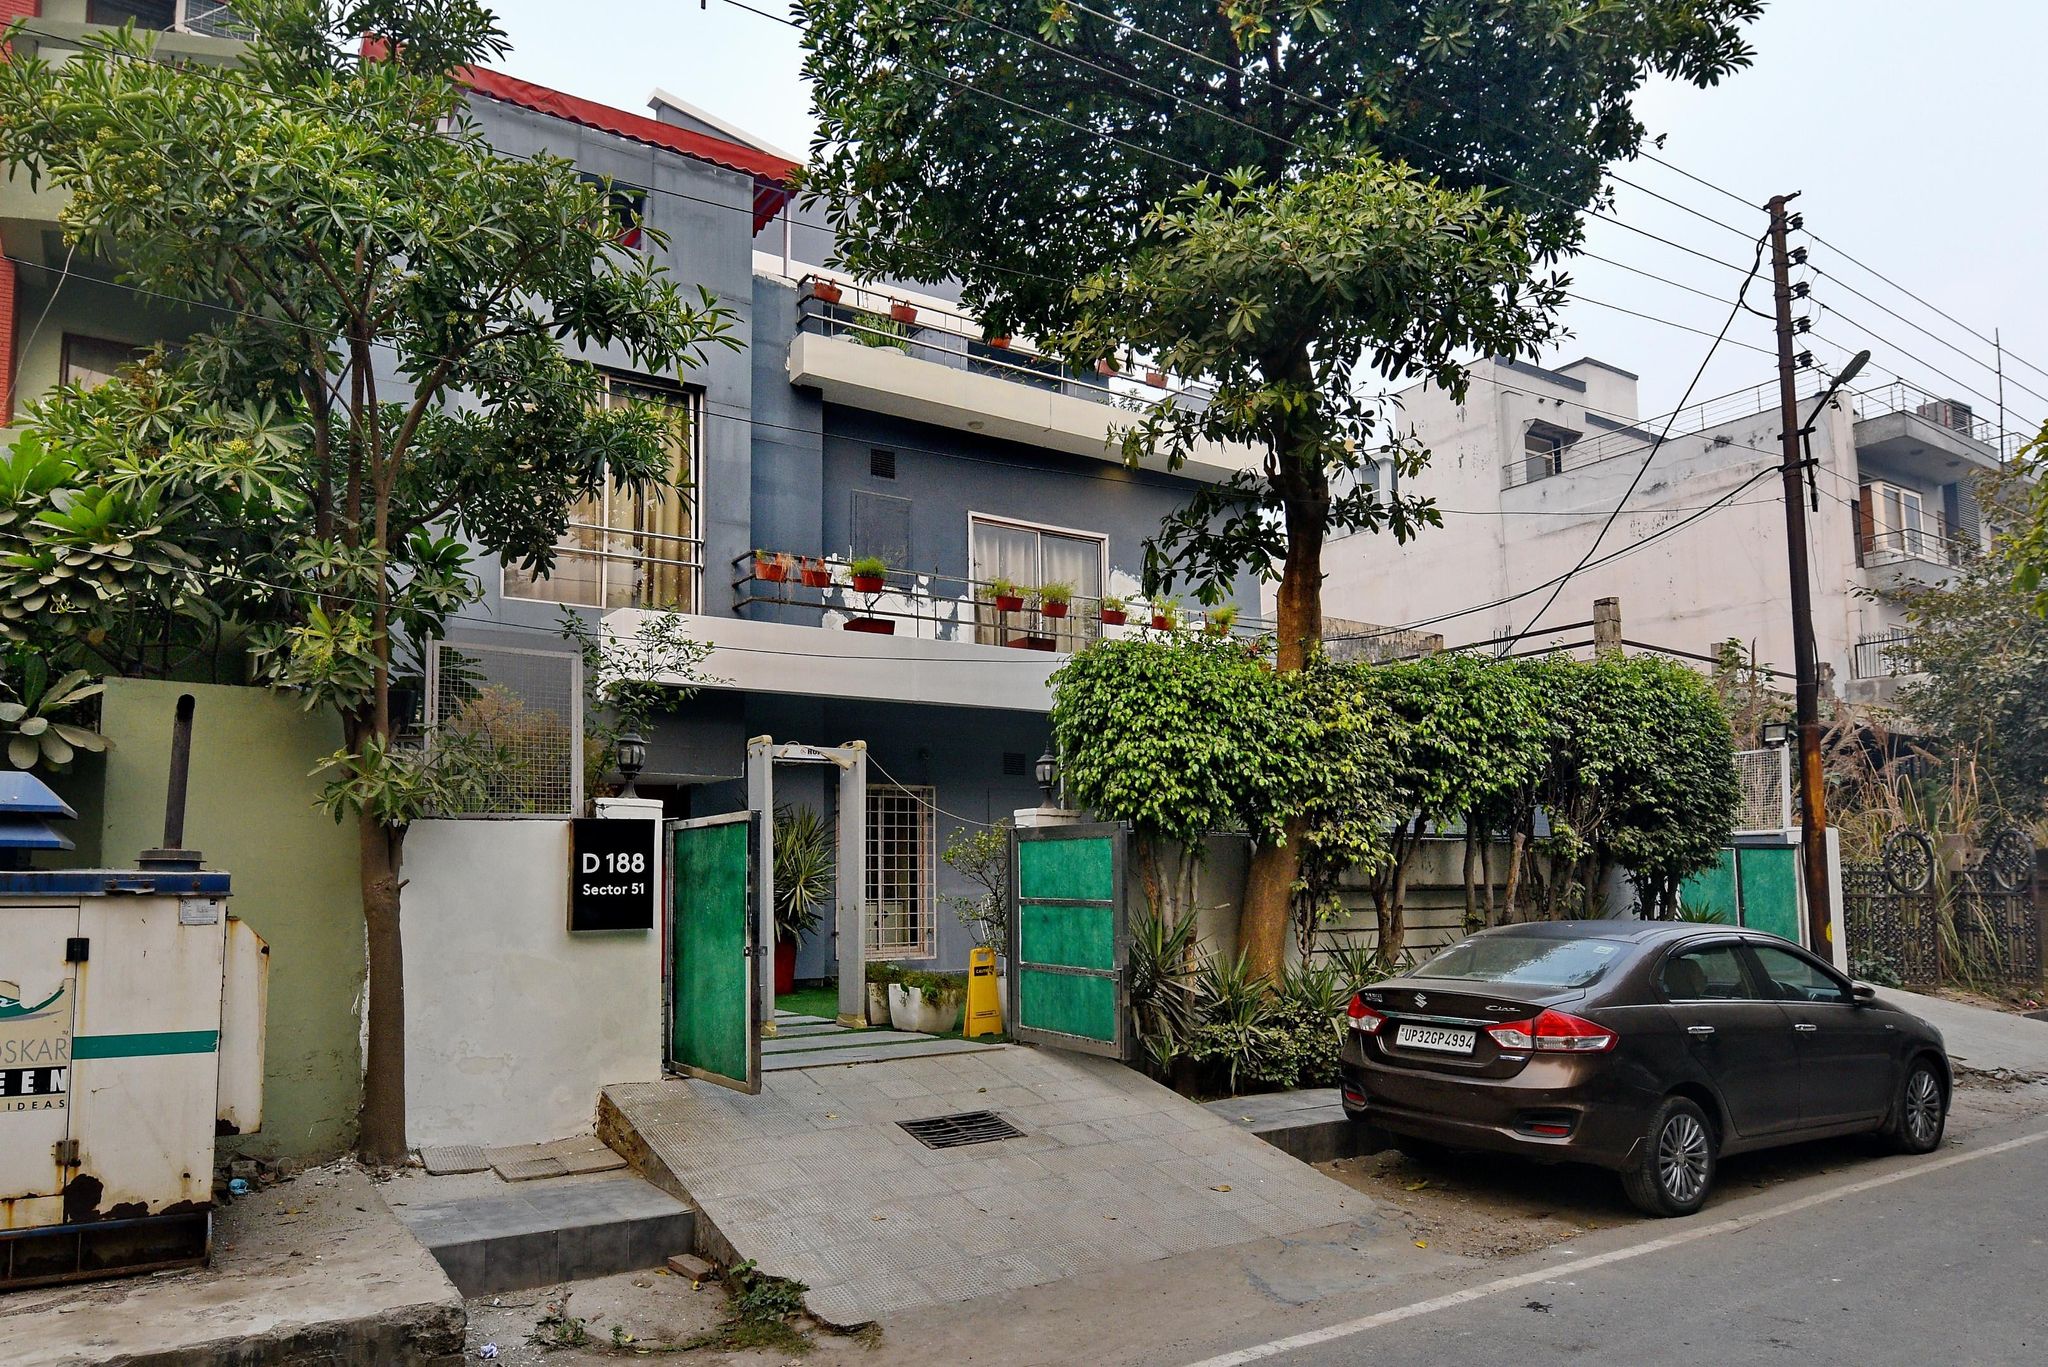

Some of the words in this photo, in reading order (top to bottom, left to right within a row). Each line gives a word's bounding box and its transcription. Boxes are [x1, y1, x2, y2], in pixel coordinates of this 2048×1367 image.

[583, 853, 600, 873] D
[606, 853, 645, 873] 188
[583, 883, 628, 895] Sector
[632, 883, 644, 894] 51
[1404, 1028, 1473, 1049] UP32GP4994
[0, 1038, 67, 1063] SKAR
[7, 1099, 65, 1111] IDEAS
